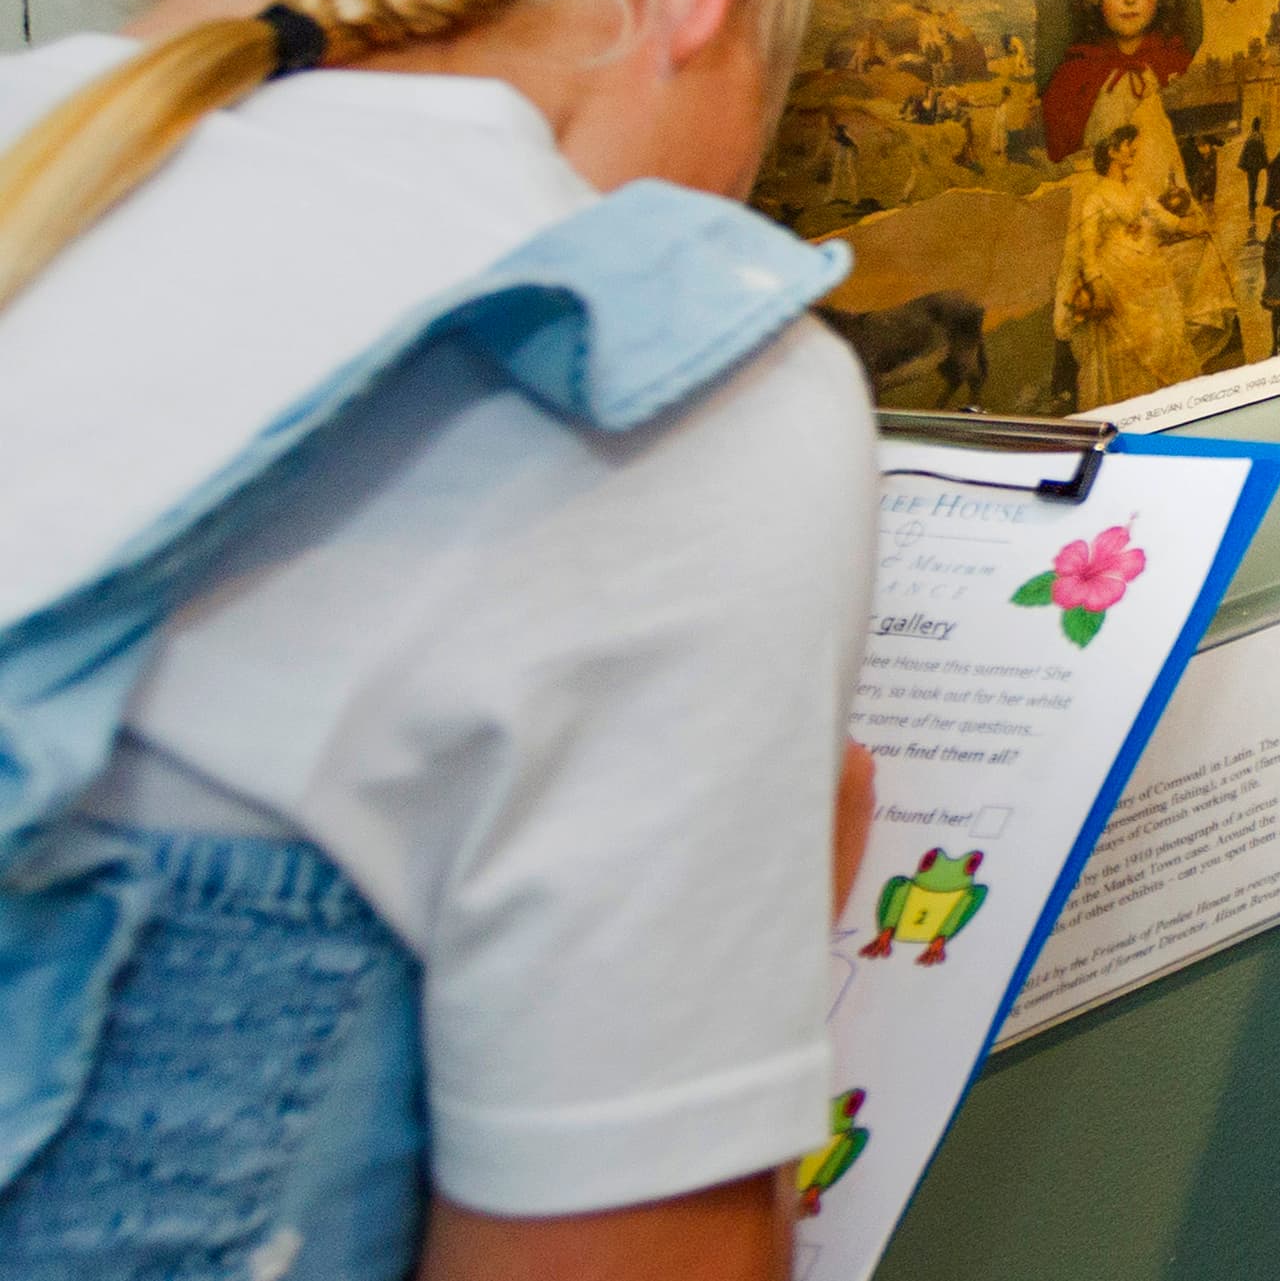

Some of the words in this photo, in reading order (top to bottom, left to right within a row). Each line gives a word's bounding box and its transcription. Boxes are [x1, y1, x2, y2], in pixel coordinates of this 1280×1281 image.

[1144, 402, 1184, 422] BEVAN
[880, 613, 957, 640] gallery
[1025, 694, 1074, 711] whilst
[904, 741, 938, 760] find
[940, 744, 985, 763] them
[885, 805, 935, 825] found
